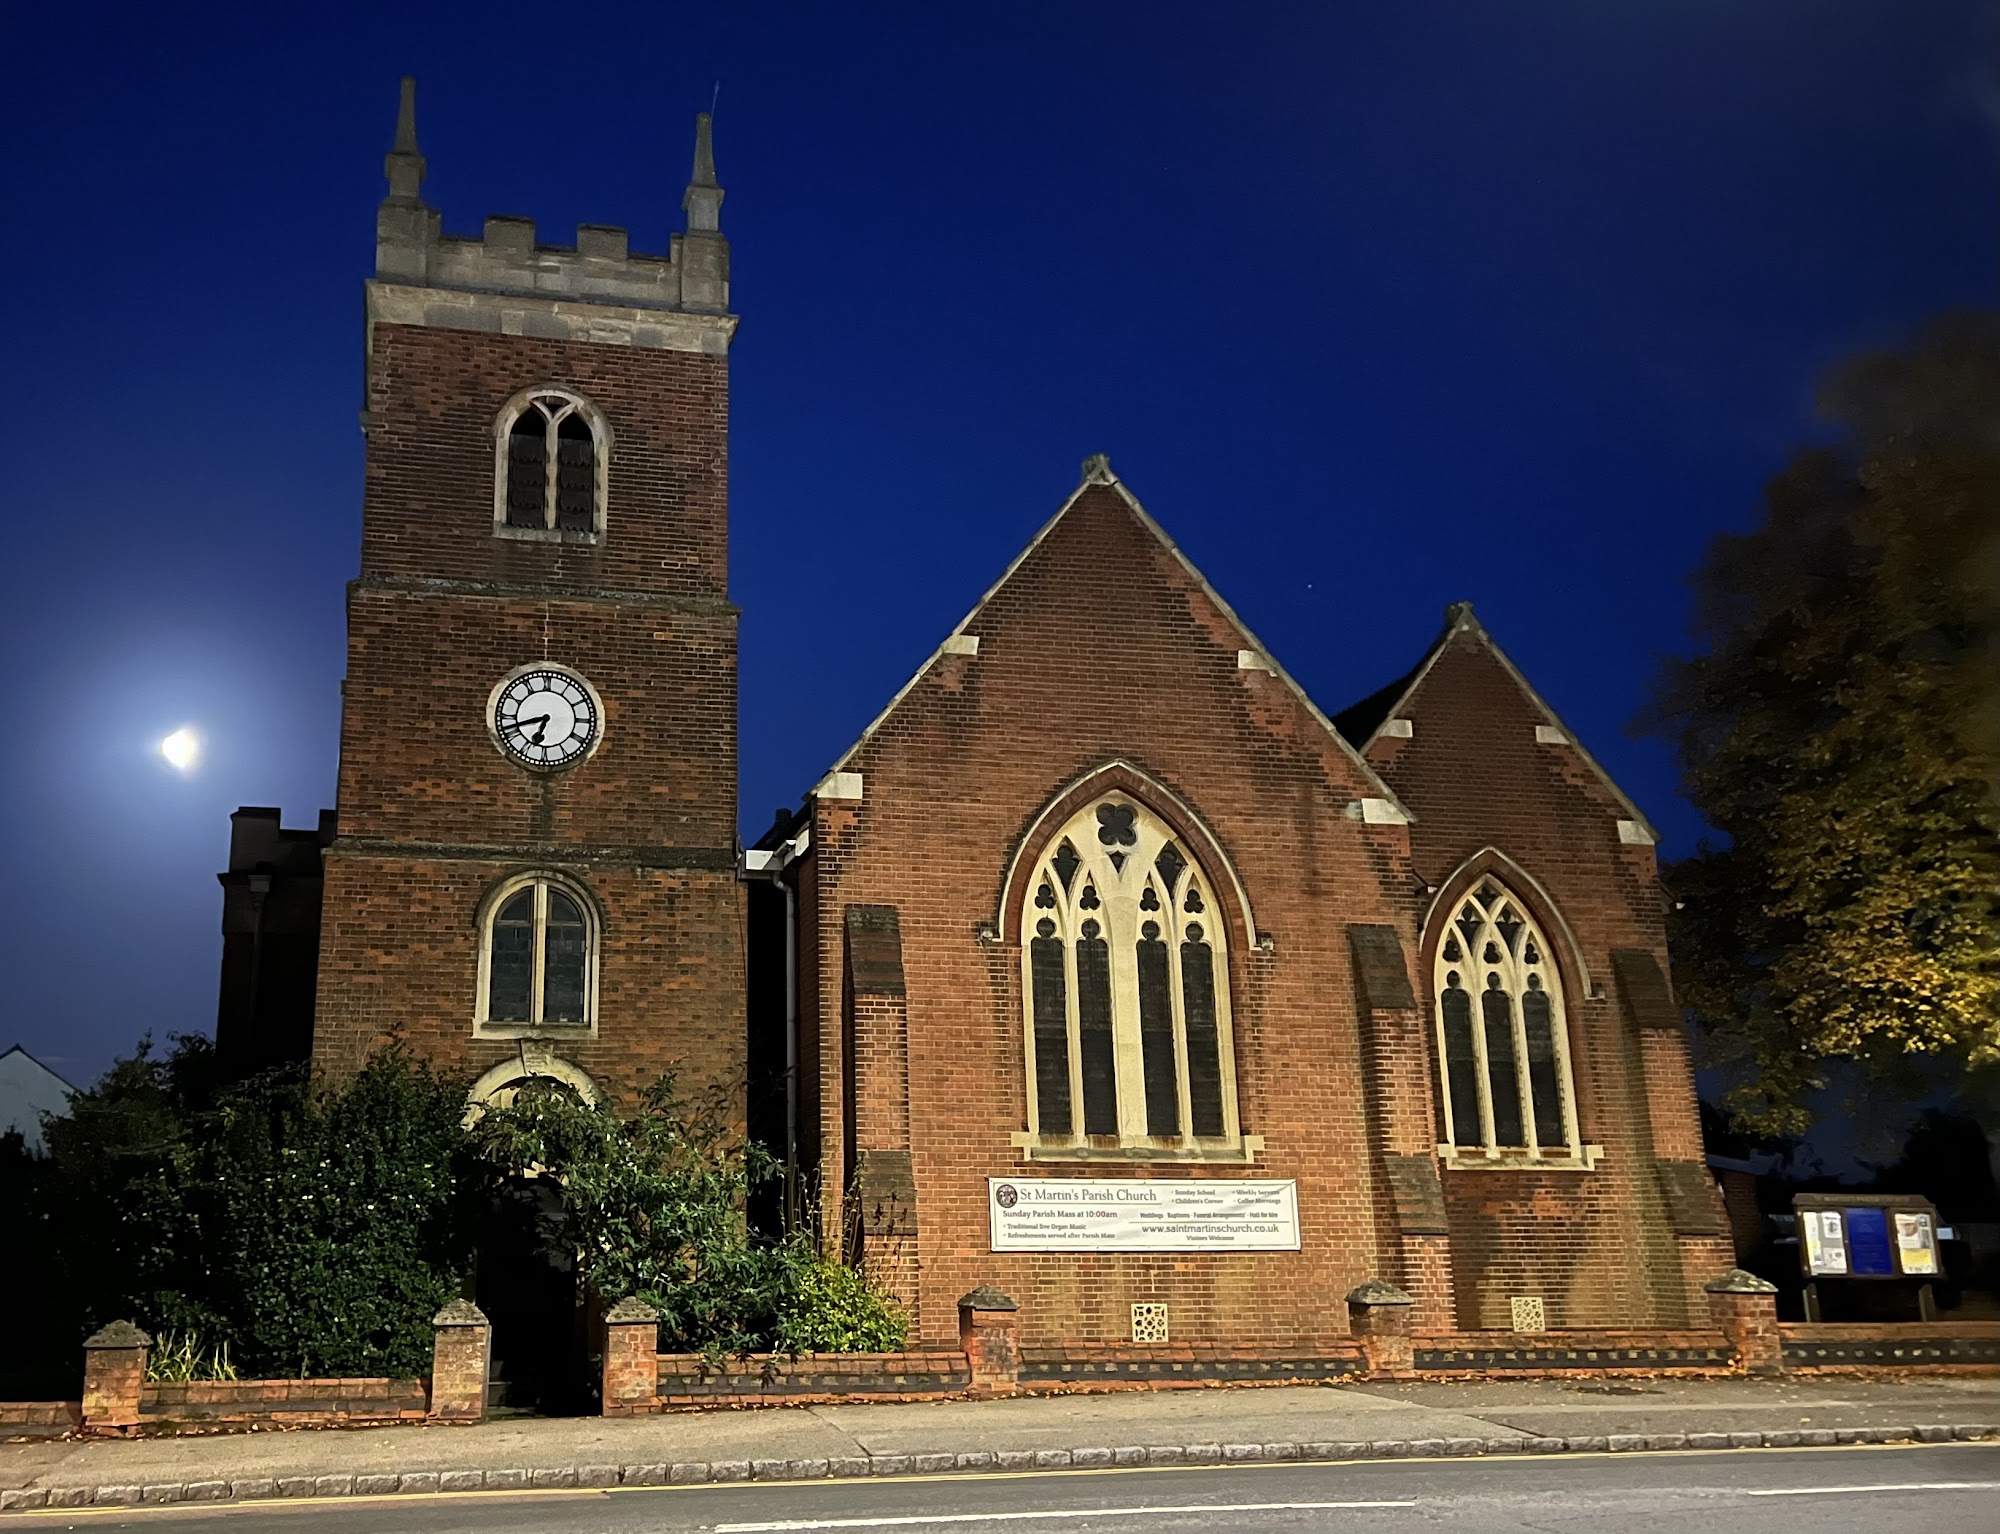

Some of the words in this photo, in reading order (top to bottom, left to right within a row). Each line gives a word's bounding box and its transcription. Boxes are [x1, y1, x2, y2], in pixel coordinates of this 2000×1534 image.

[1020, 1188, 1031, 1200] St
[1035, 1188, 1079, 1200] Martin's
[1082, 1188, 1114, 1201] Parish
[1116, 1188, 1157, 1201] Church
[1002, 1210, 1031, 1219] Sunday
[1032, 1210, 1056, 1218] Parish
[1057, 1210, 1076, 1218] Mass
[1077, 1210, 1084, 1218] at
[1085, 1210, 1118, 1218] 10:00am
[1051, 1223, 1068, 1231] Organ
[1142, 1224, 1279, 1233] www.saintmartinschurch.co.uk
